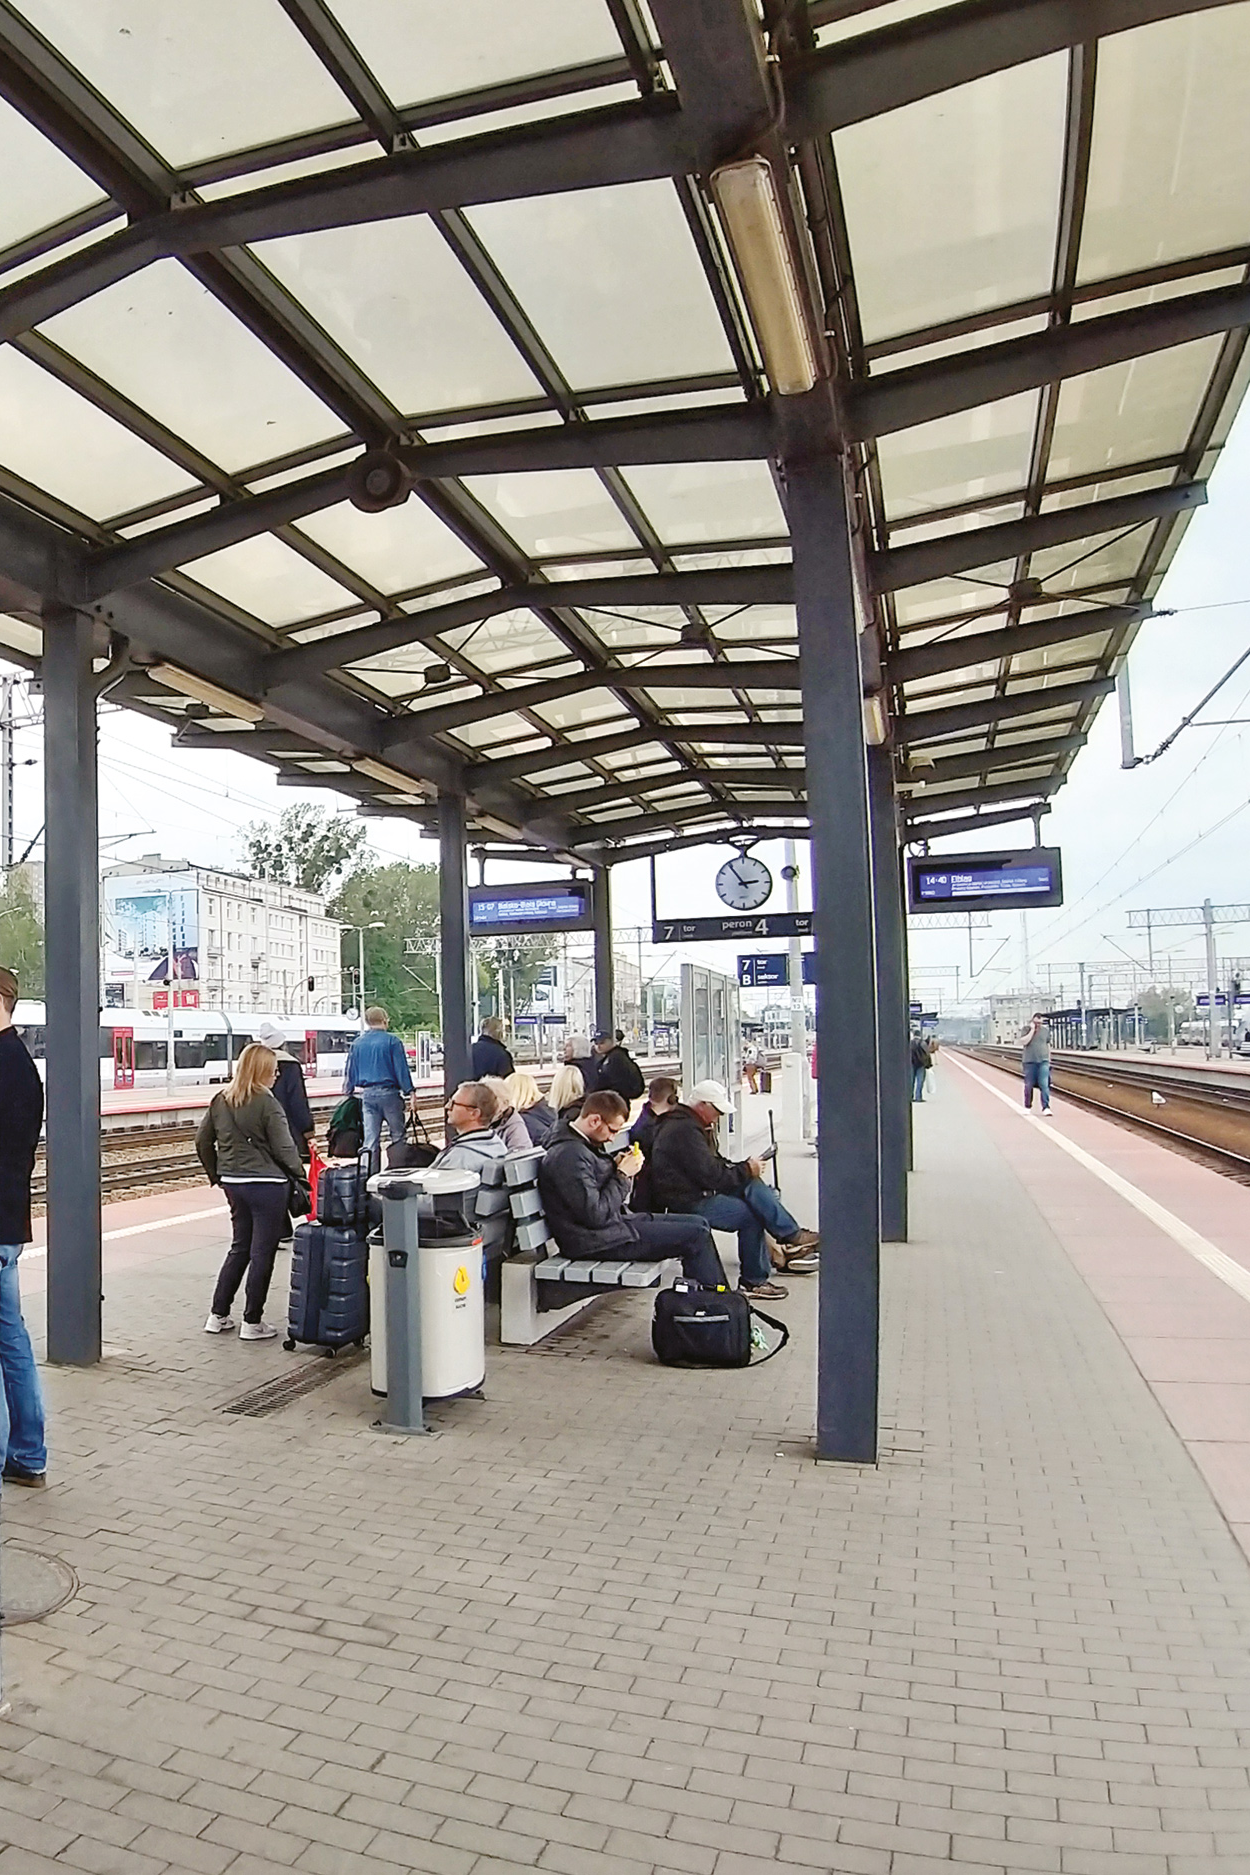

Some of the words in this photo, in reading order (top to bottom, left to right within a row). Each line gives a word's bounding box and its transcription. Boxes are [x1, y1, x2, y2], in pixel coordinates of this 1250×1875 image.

[663, 925, 675, 940] 7
[682, 924, 697, 933] tor
[721, 919, 753, 931] peron
[754, 918, 770, 936] 4
[741, 959, 752, 971] 7
[742, 974, 752, 986] B
